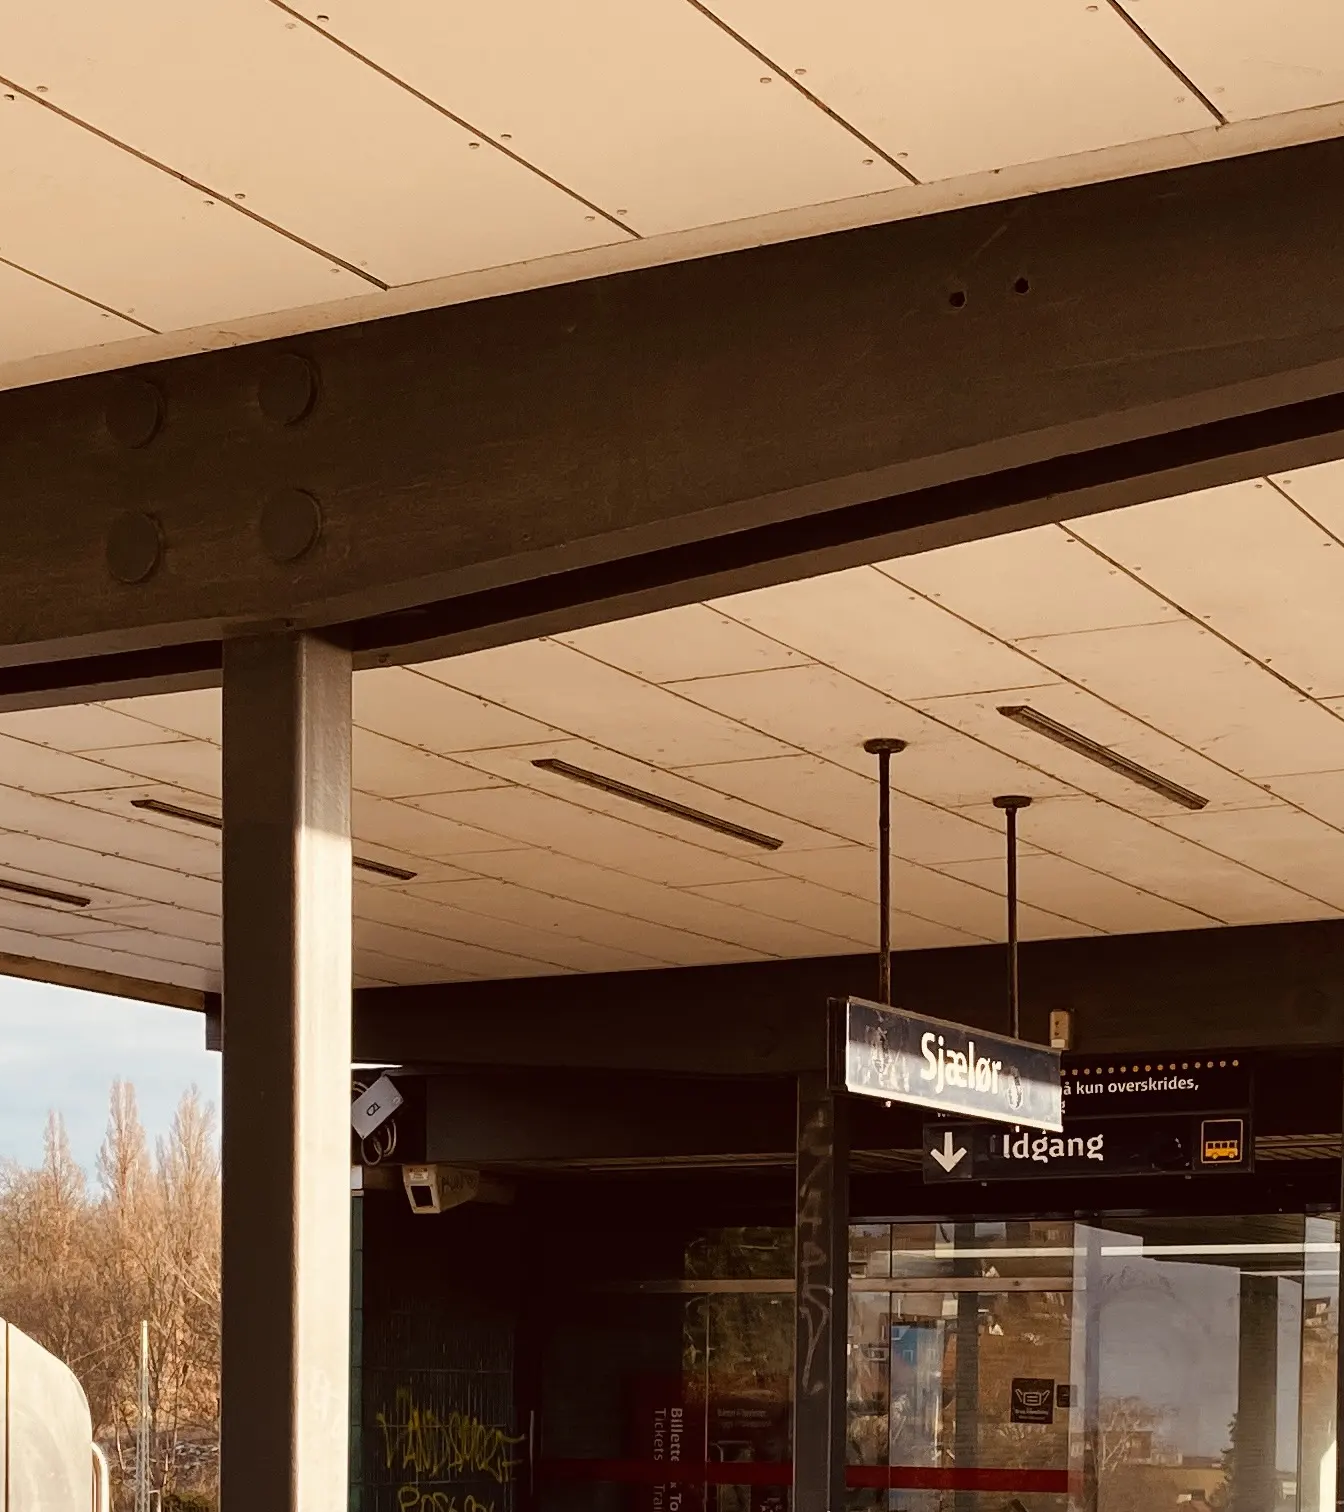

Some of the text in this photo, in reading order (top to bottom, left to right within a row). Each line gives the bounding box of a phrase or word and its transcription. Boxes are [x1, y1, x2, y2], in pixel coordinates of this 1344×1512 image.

[920, 1032, 1002, 1095] Sjælør
[1076, 1081, 1104, 1096] kun
[1107, 1075, 1199, 1095] overskrides,
[653, 1407, 666, 1461] Tickets
